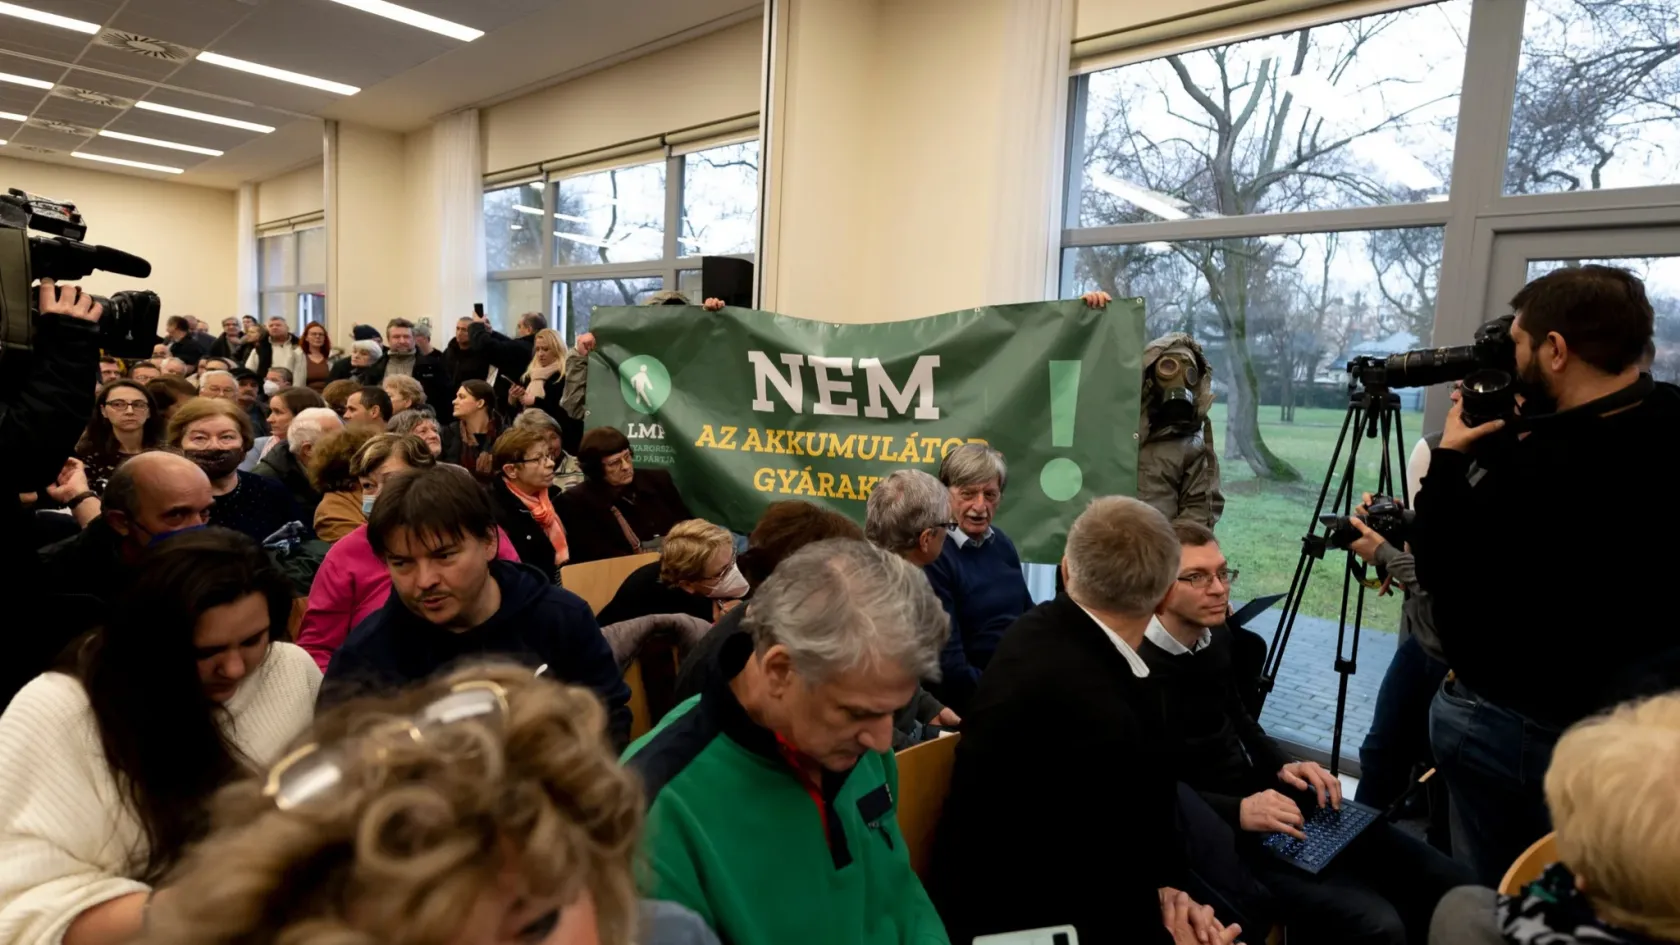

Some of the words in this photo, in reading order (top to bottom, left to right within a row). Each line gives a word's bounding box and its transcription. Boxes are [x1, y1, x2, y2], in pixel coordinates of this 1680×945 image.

[747, 350, 941, 420] NEM
[695, 425, 737, 451] AZ
[740, 428, 989, 464] AKKUMULÁTO
[753, 463, 884, 501] GYÁRAK
